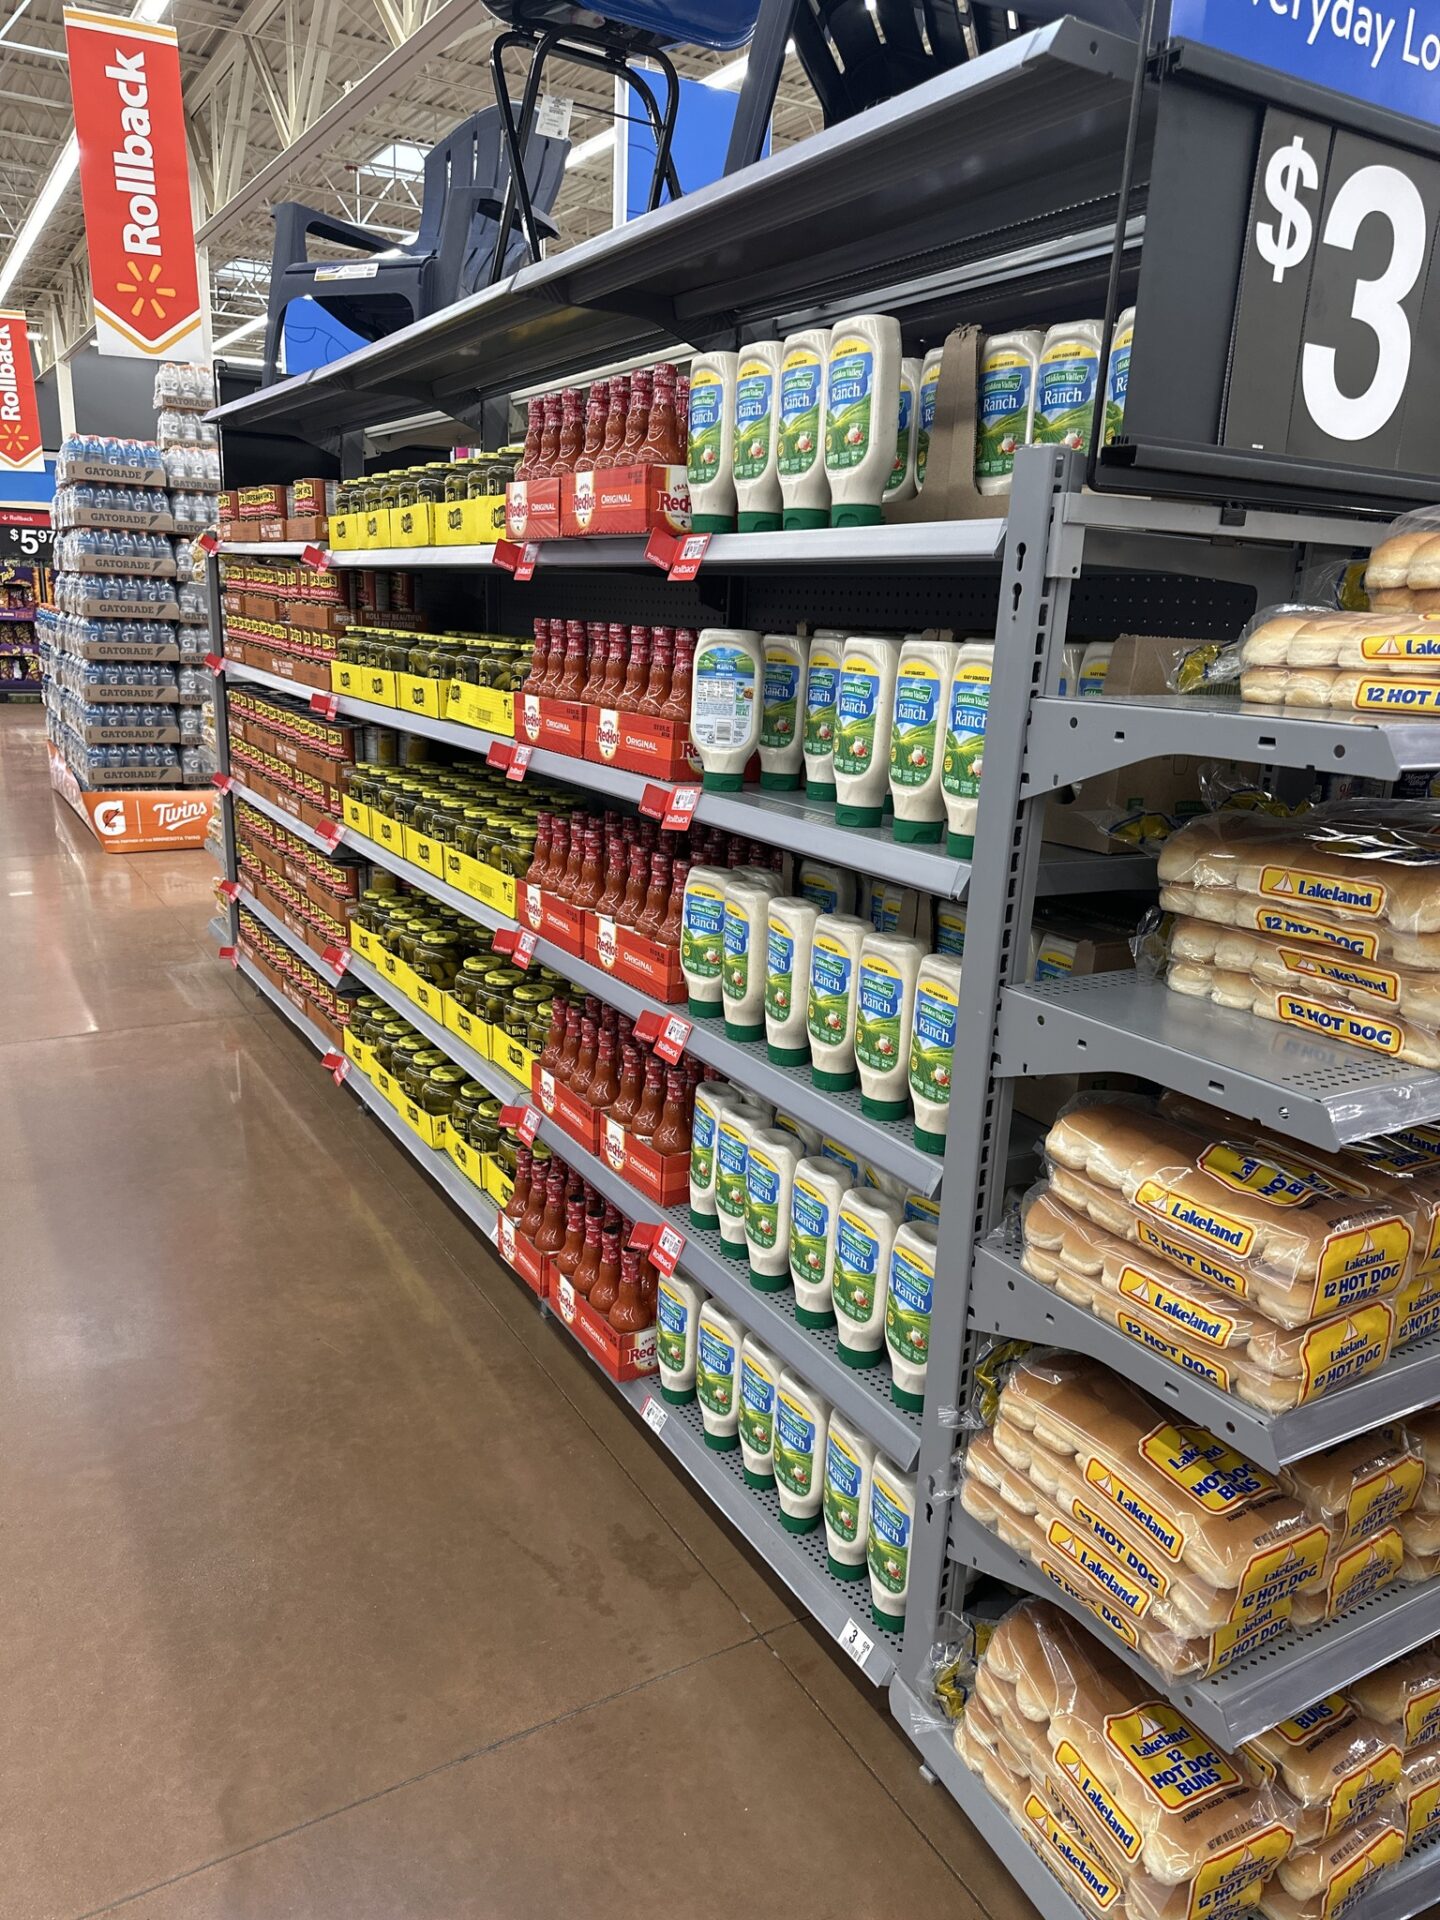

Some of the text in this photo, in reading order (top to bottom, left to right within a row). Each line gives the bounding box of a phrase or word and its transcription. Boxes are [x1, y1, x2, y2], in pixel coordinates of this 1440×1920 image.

[104, 48, 161, 257] Rollback
[798, 375, 813, 388] Valley
[848, 365, 863, 378] Valley
[1045, 369, 1086, 384] Hidden Valley
[832, 384, 860, 402] Ranch
[1001, 379, 1020, 390] Valley
[166, 397, 212, 407] GATORADE
[784, 393, 809, 410] Ranch
[983, 395, 1017, 412] Ranch
[1044, 387, 1082, 405] Ranch
[692, 409, 712, 423] Ranch
[739, 402, 761, 417] Ranch
[85, 467, 141, 479] GATORADE
[531, 503, 556, 512] ORIGINAL
[601, 494, 632, 505] ORIGINAL
[91, 513, 147, 524] GATORADE
[95, 559, 150, 570] GATORADE
[100, 604, 154, 615] GATORADE
[99, 646, 153, 656] GATORADE
[100, 688, 152, 698] GATORADE
[809, 688, 830, 702] Ranch
[854, 685, 870, 697] Valley
[912, 690, 929, 702] Valley
[957, 692, 975, 704] Hidden
[1367, 688, 1431, 705] 12 HOT
[841, 699, 866, 715] Ranch
[899, 703, 926, 721] Ranch
[101, 729, 154, 739] GATORADE
[546, 719, 571, 732] ORIGINAL
[626, 735, 658, 751] ORIGINAL
[104, 770, 157, 779] GATORADE
[94, 800, 207, 835] G Twins
[666, 815, 689, 824] Rollback
[1298, 880, 1372, 907] Lakeland
[547, 913, 570, 931] ORIGINAL
[690, 913, 717, 930] Ranch
[1264, 916, 1283, 930] 12
[624, 952, 654, 973] ORIGINAL
[814, 970, 839, 991] Ranch
[1319, 964, 1388, 994] Lakeland
[863, 991, 890, 1014] Ranch
[919, 1017, 949, 1043] Ranch
[1289, 1002, 1393, 1045] 12 HOT DOG
[560, 1103, 584, 1127] ORIGINAL
[630, 1156, 658, 1183] ORIGINAL
[719, 1149, 740, 1173] Ranch
[795, 1211, 819, 1234] Ranch
[1171, 1202, 1244, 1247] Lakeland
[840, 1242, 868, 1271] Ranch
[1145, 1229, 1238, 1290] 12 HOT DOG
[1344, 1250, 1385, 1272] Lakeland
[1323, 1263, 1400, 1298] 12 HOT DOG
[894, 1278, 925, 1311] Ranch
[1155, 1285, 1222, 1339] Lakeland
[1408, 1311, 1430, 1333] HOT
[580, 1316, 608, 1350] ORIGINAL
[1126, 1321, 1218, 1383] 12 HOT DOG
[1330, 1334, 1368, 1362] Lakeland
[702, 1347, 725, 1373] Ranch
[1314, 1344, 1382, 1390] 12 HOT DOG
[743, 1382, 765, 1412] Ranch
[780, 1421, 805, 1450] Ranch
[829, 1464, 851, 1495] Ranch
[874, 1509, 899, 1543] Ranch
[1116, 1489, 1176, 1550] Lakeland
[1361, 1510, 1385, 1531] HOT
[1092, 1519, 1160, 1590] HOT DOG
[1079, 1550, 1139, 1609] Lakeland
[1264, 1557, 1305, 1584] Lakeland
[1242, 1565, 1318, 1609] 12 HOT DOG
[1236, 1609, 1273, 1639] Lakeland
[849, 1630, 858, 1643] 3
[1217, 1617, 1288, 1665] 12 HOT DOG
[1295, 1703, 1334, 1730] BUNS
[1130, 1726, 1192, 1758] Lakeland
[1166, 1749, 1185, 1762] 12
[1150, 1751, 1221, 1790] HOT DOG
[1175, 1768, 1222, 1798] BUNS
[1081, 1777, 1134, 1850] Lakeland
[1183, 1808, 1202, 1823] JUMBO
[1052, 1832, 1109, 1899] Lakeland
[1198, 1877, 1248, 1909] 12 HOT
